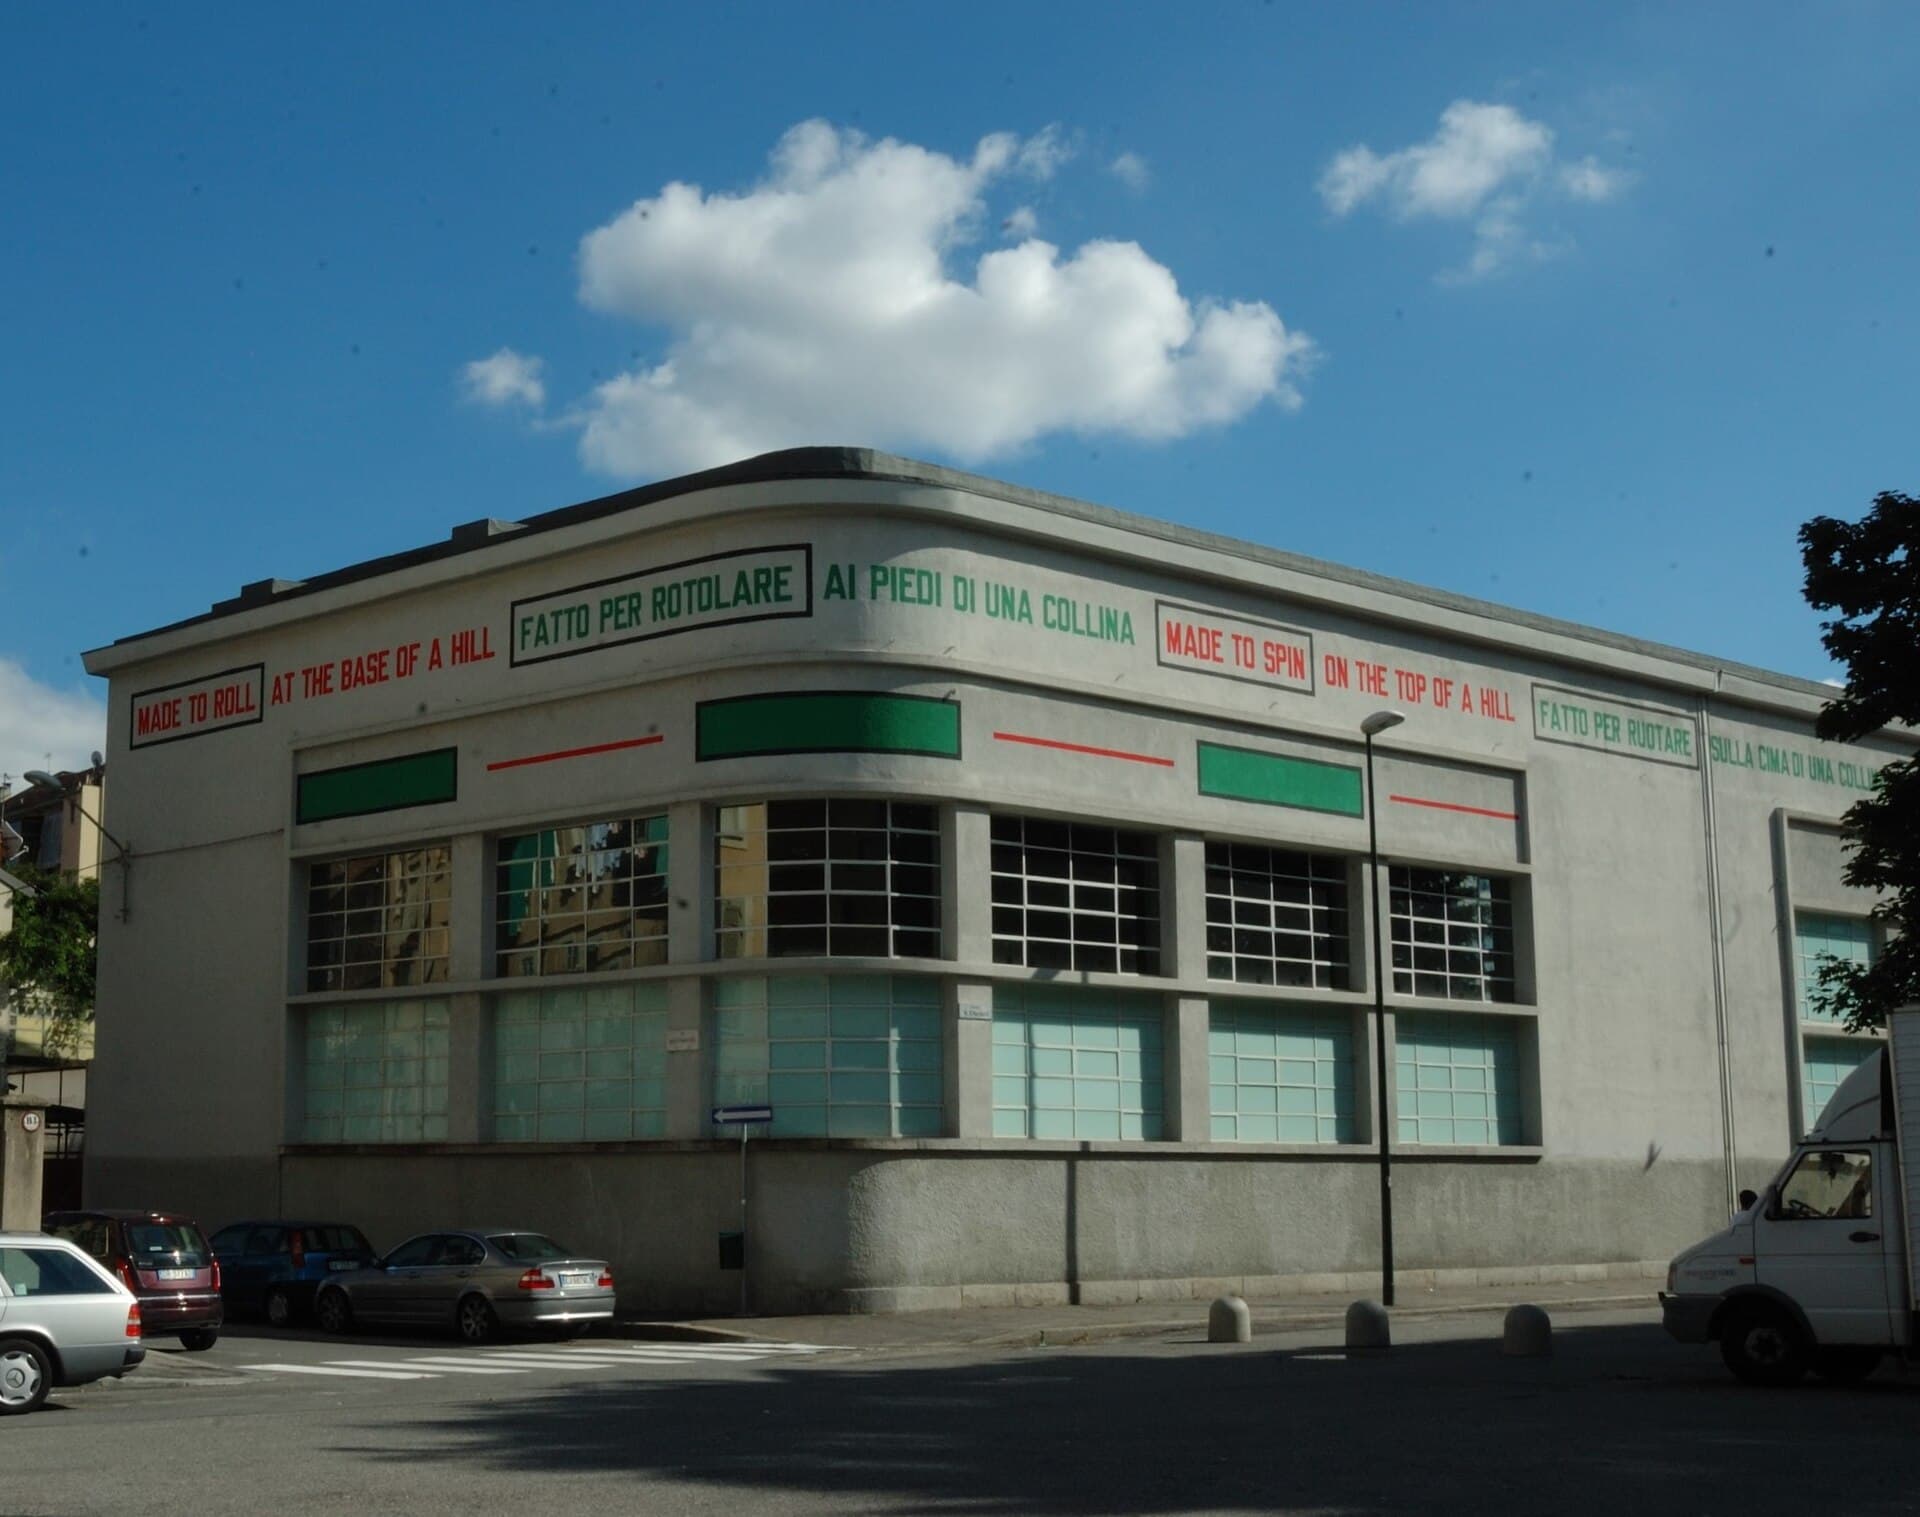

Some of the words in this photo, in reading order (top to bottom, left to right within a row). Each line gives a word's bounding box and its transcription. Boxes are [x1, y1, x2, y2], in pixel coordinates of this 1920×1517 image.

[521, 603, 589, 651] FATTO
[600, 591, 641, 634] PER
[652, 565, 793, 623] ROTOLARE
[823, 563, 856, 601] AI
[868, 564, 942, 608] PIEDI
[953, 575, 975, 613] DI
[984, 583, 1034, 625] UNA
[1043, 594, 1136, 646] COLLINA
[271, 672, 295, 706] AT
[302, 663, 334, 698] THE
[341, 650, 389, 691] BASE
[396, 643, 420, 678] OF
[428, 638, 442, 671] A
[451, 627, 495, 665] HILL
[1166, 620, 1224, 664] MADE
[1231, 633, 1256, 671] TO
[1263, 641, 1306, 681] SPIN
[138, 698, 181, 736] MADE
[189, 692, 207, 724] TO
[214, 682, 255, 718] ROLL
[1324, 654, 1349, 688] ON
[1355, 660, 1389, 698] THE
[1395, 669, 1427, 703] TOP
[1433, 677, 1453, 708] OF
[1461, 684, 1473, 713] A
[1480, 690, 1515, 722] HILL
[1540, 700, 1588, 737] FATTO
[1594, 712, 1621, 742] PER
[1627, 720, 1692, 757] RUOTARE
[1710, 735, 1754, 769] SULLA
[1758, 745, 1790, 776] CIMA
[1792, 751, 1805, 778] DI
[1808, 755, 1835, 784] UNA
[1838, 761, 1877, 791] COLLI
